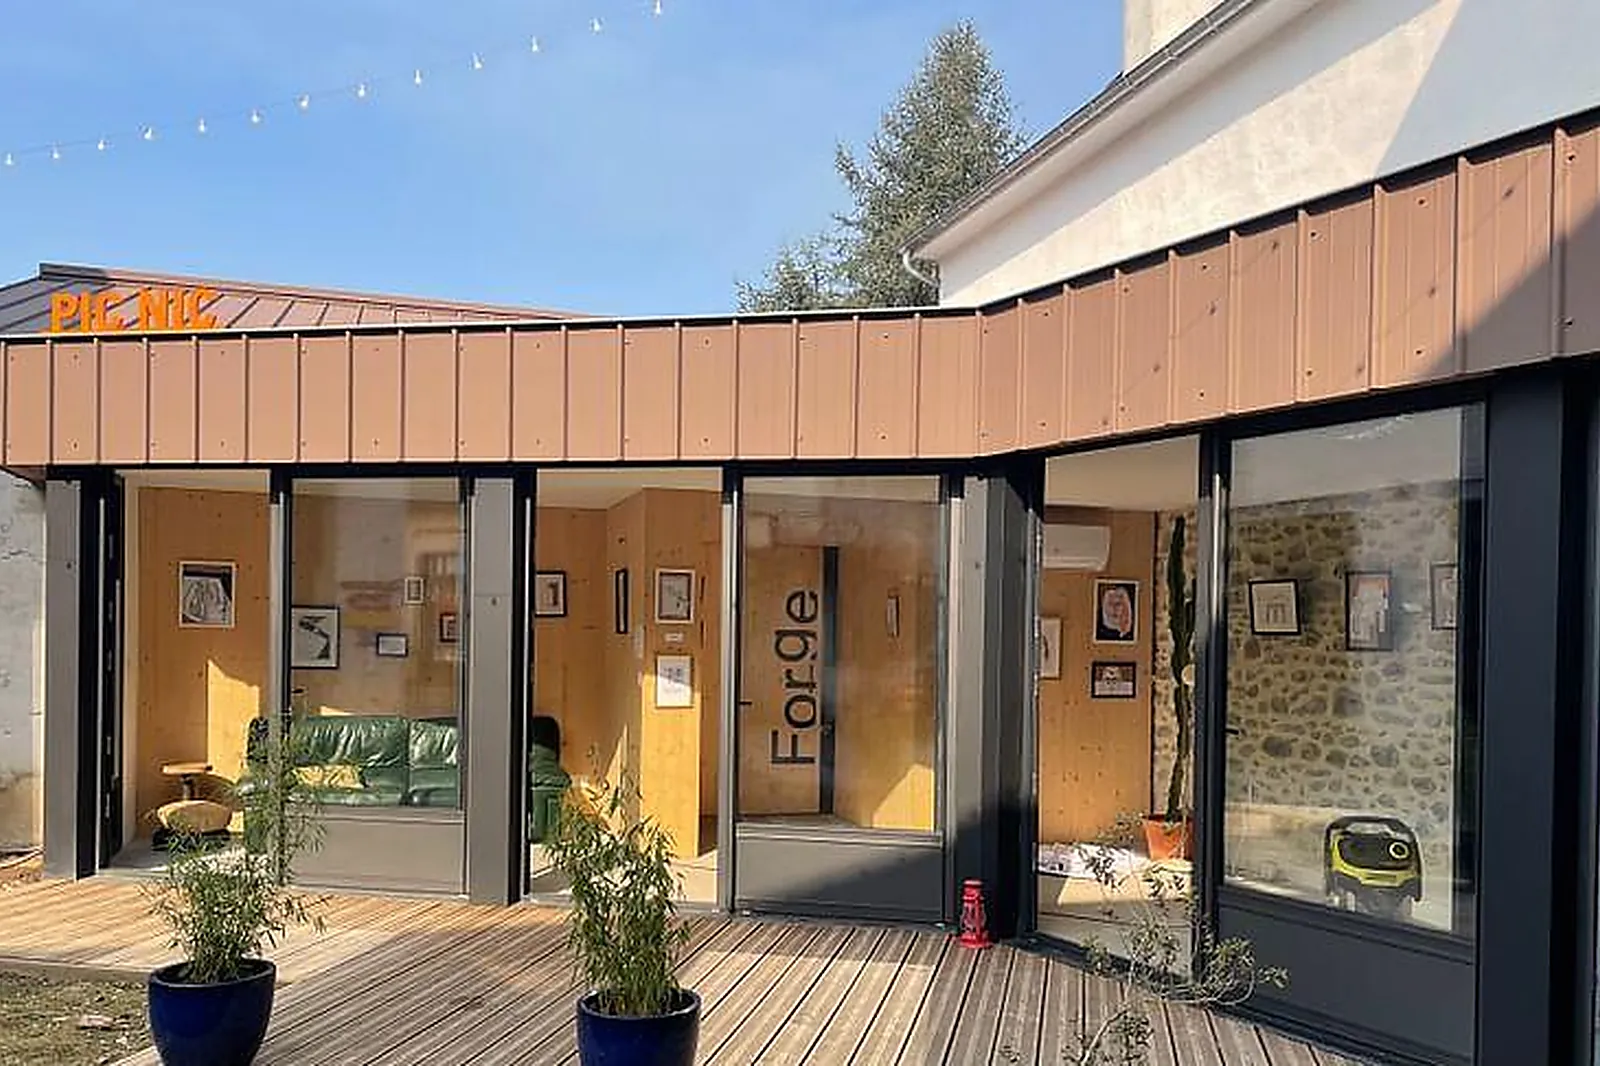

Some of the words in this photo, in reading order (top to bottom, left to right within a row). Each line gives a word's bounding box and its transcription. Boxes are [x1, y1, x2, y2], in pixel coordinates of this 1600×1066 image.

[50, 291, 125, 333] PIC
[138, 286, 217, 331] NIC
[770, 590, 819, 765] Forge
